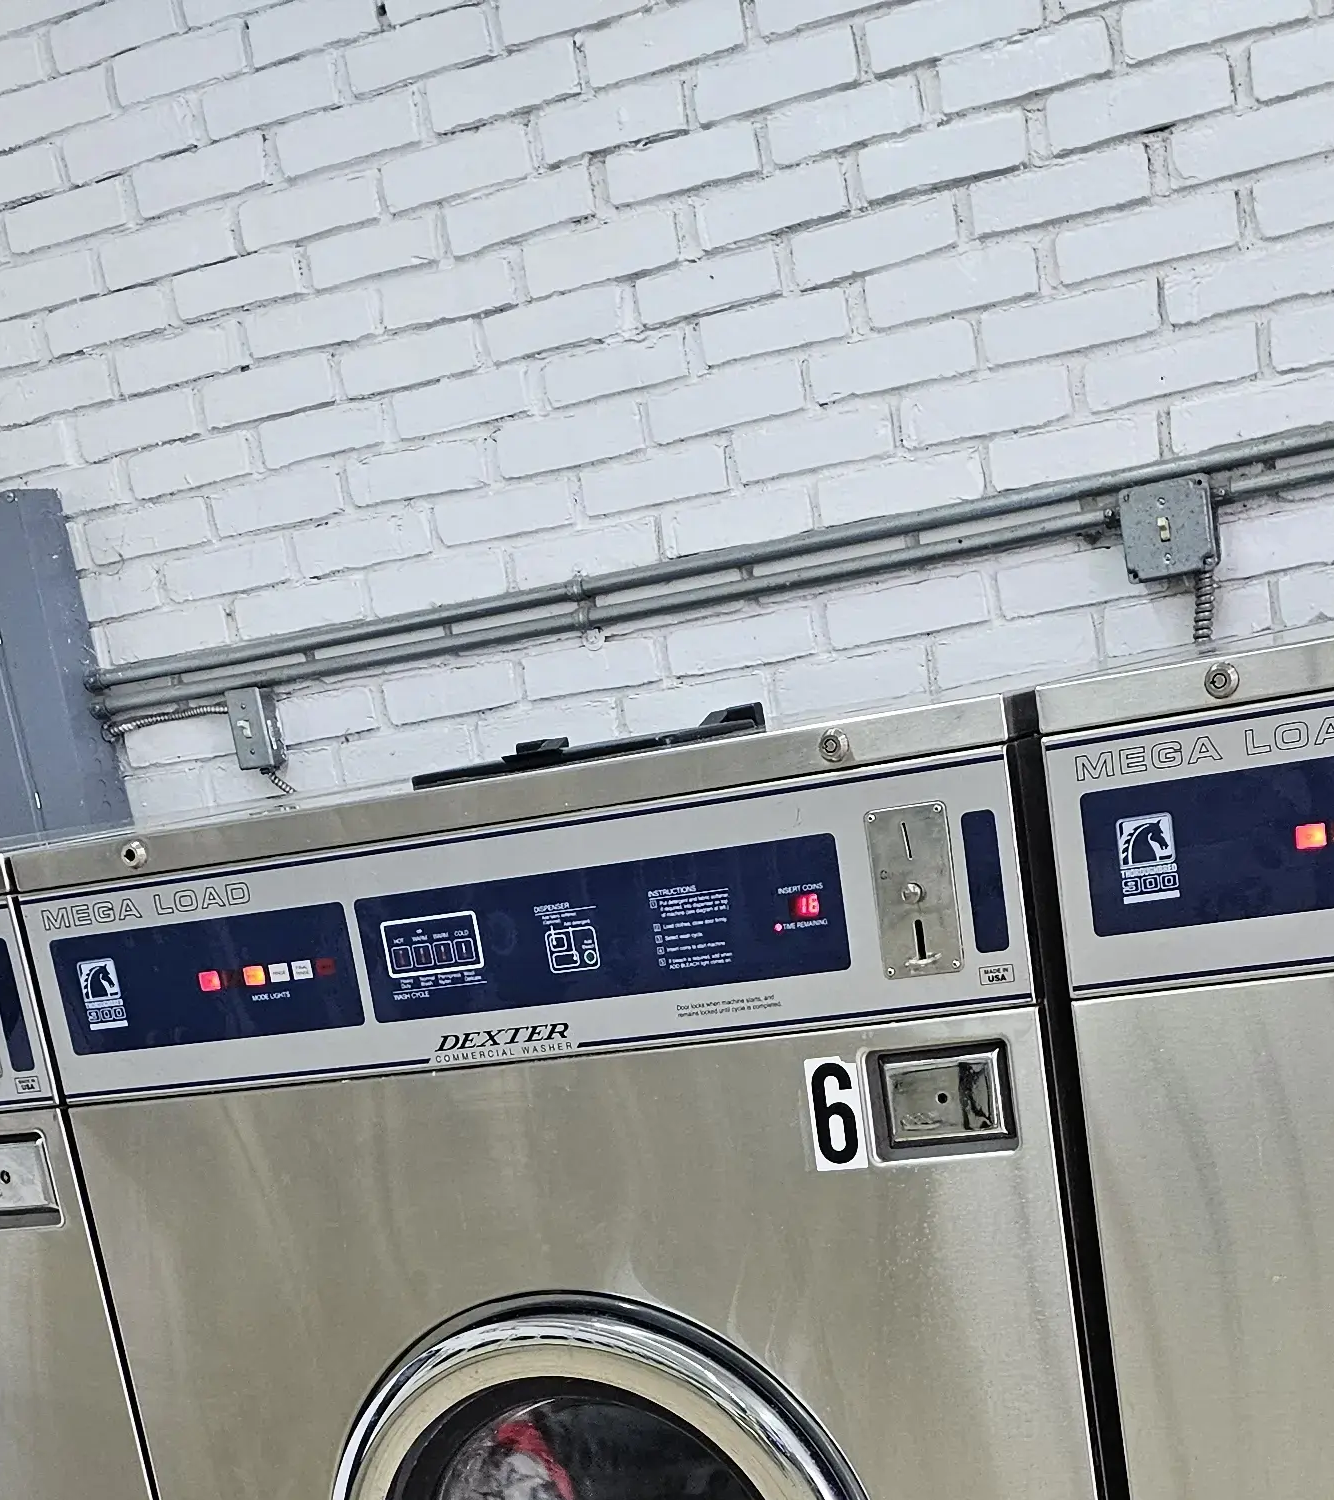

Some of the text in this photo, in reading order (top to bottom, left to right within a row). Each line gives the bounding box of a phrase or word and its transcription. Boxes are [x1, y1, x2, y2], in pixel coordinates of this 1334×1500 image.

[1075, 736, 1222, 781] MEGA
[648, 885, 696, 897] INSTRUCTIONS
[777, 882, 823, 894] INSERT COINS
[41, 882, 250, 931] MEGA LOAD
[797, 919, 828, 928] REMAINING
[988, 974, 1006, 982] USA
[270, 991, 290, 999] LIGHTS
[435, 1022, 569, 1052] DEXTER
[436, 1042, 572, 1063] COMMERCIAL WASHER
[812, 1063, 858, 1164] 6
